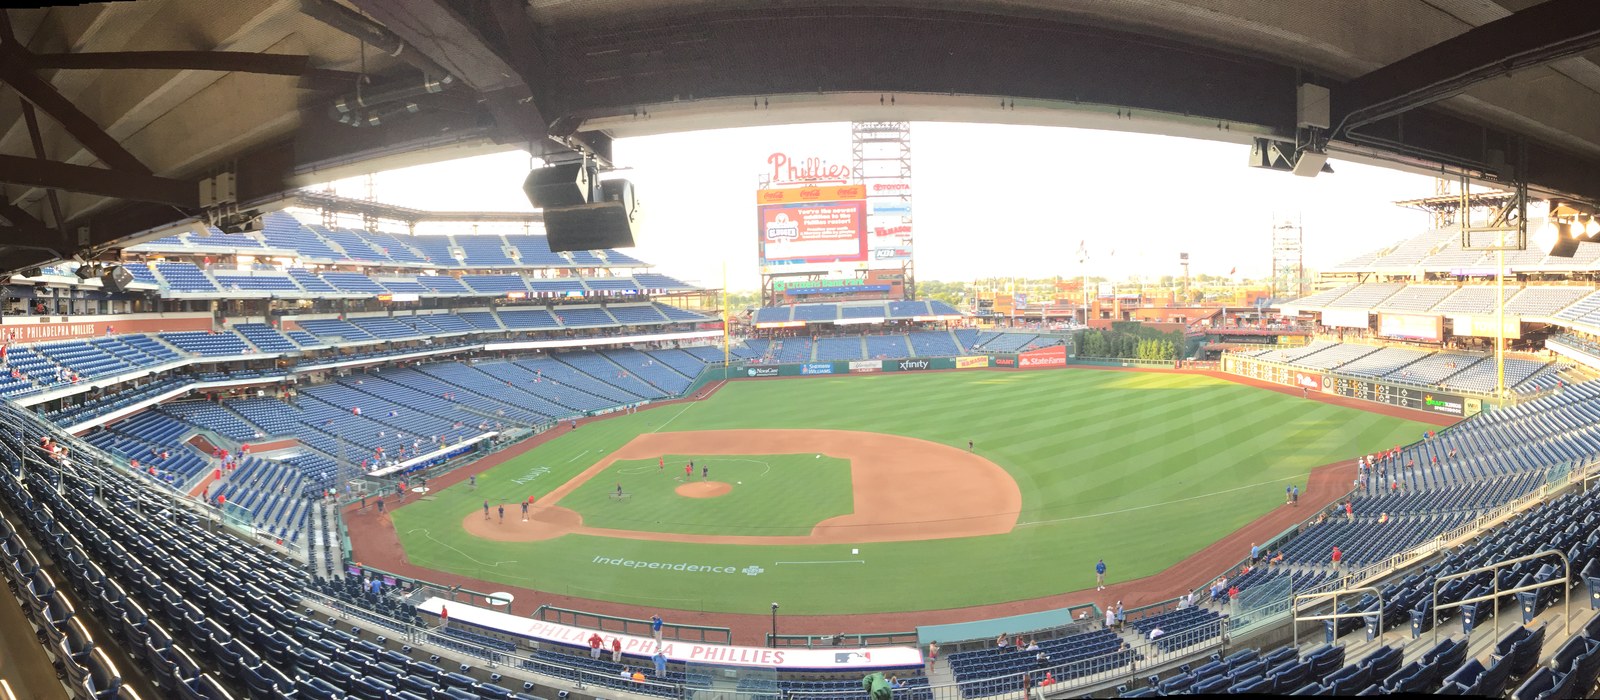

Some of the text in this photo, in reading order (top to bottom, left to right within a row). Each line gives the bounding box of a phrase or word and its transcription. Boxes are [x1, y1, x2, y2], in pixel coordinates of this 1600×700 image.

[768, 153, 850, 182] Phillies
[787, 281, 821, 289] Citizens
[822, 279, 845, 287] Bank
[846, 278, 864, 286] Park
[900, 360, 928, 371] xfinity
[592, 555, 737, 574] Independence
[690, 646, 785, 665] PHILLIES
